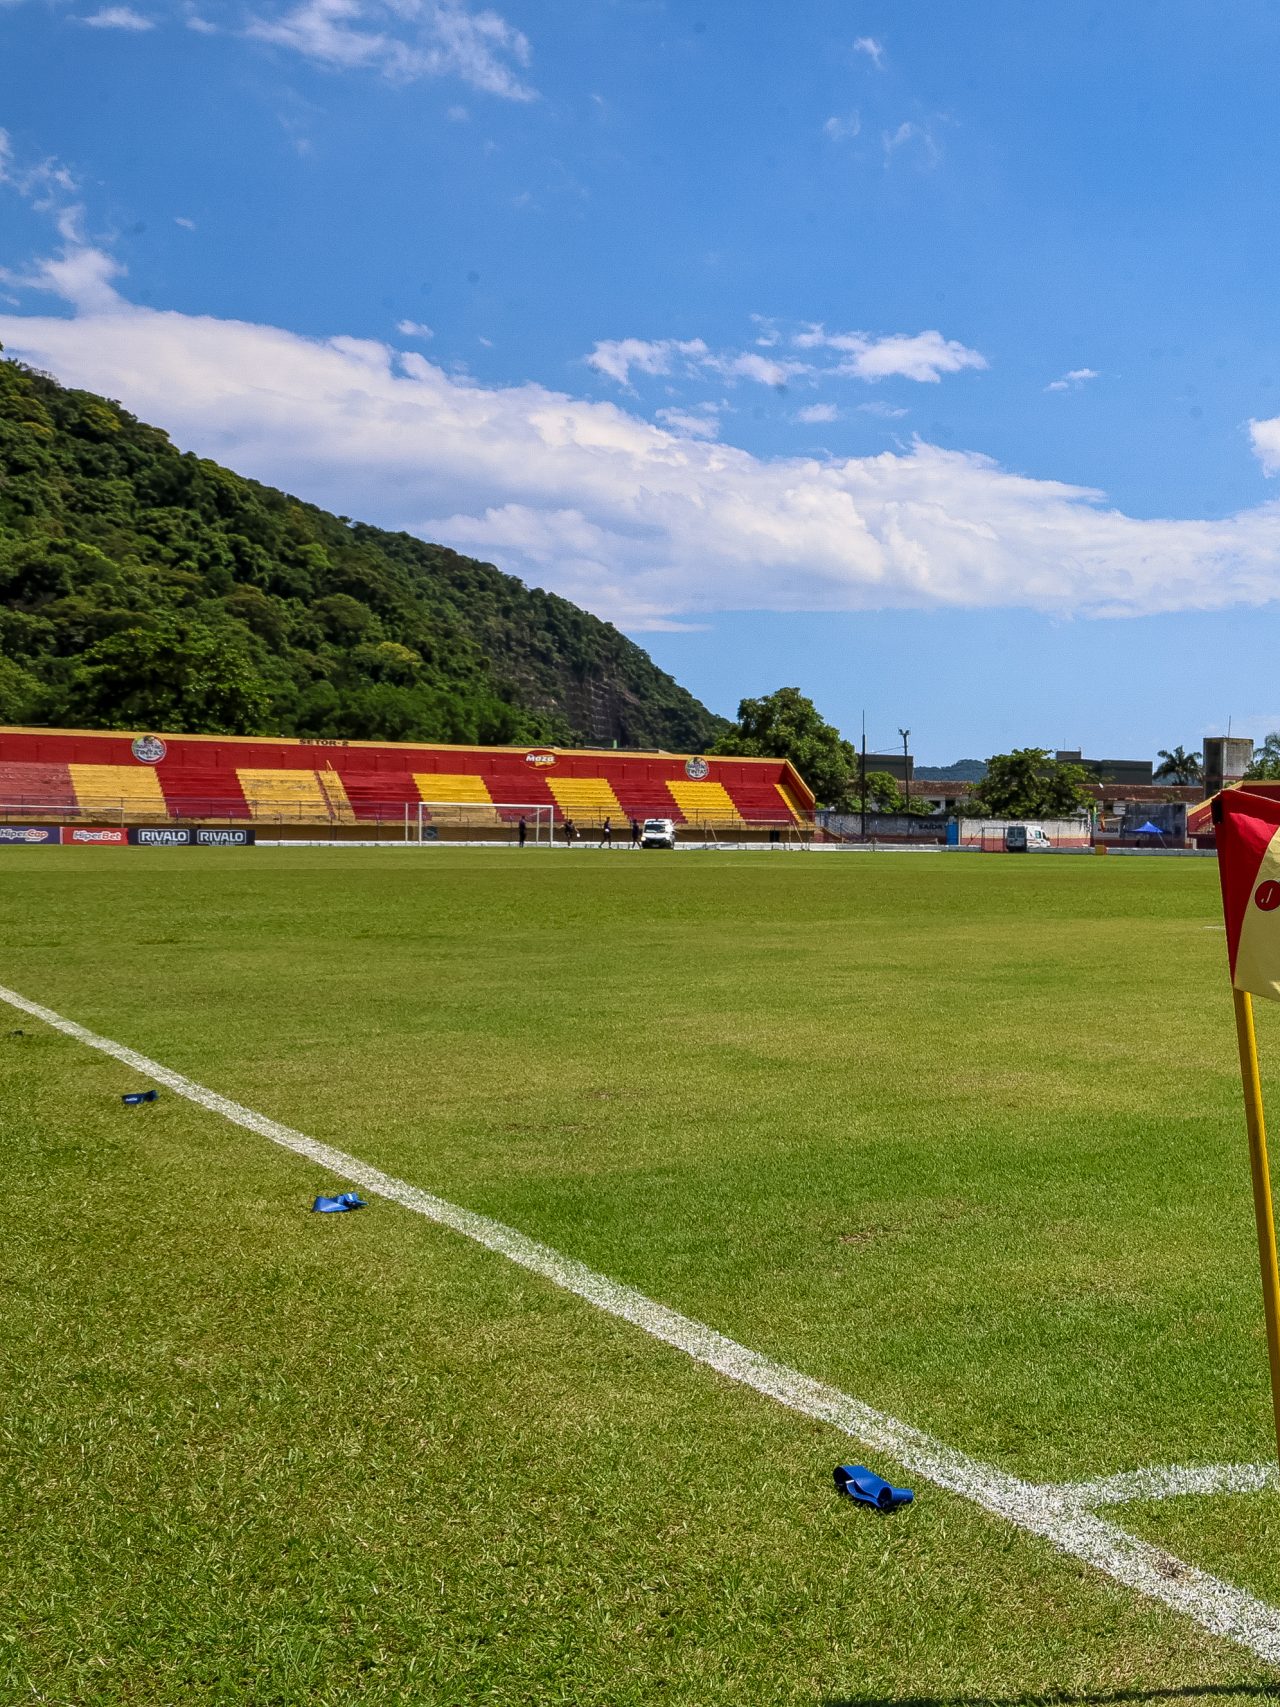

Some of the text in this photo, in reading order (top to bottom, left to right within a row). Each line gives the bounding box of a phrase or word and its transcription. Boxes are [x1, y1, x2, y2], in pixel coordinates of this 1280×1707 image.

[0, 828, 48, 839] HiperCap
[73, 830, 121, 842] HiperBet
[141, 831, 187, 841] RIVALO
[200, 832, 244, 842] RIVALO
